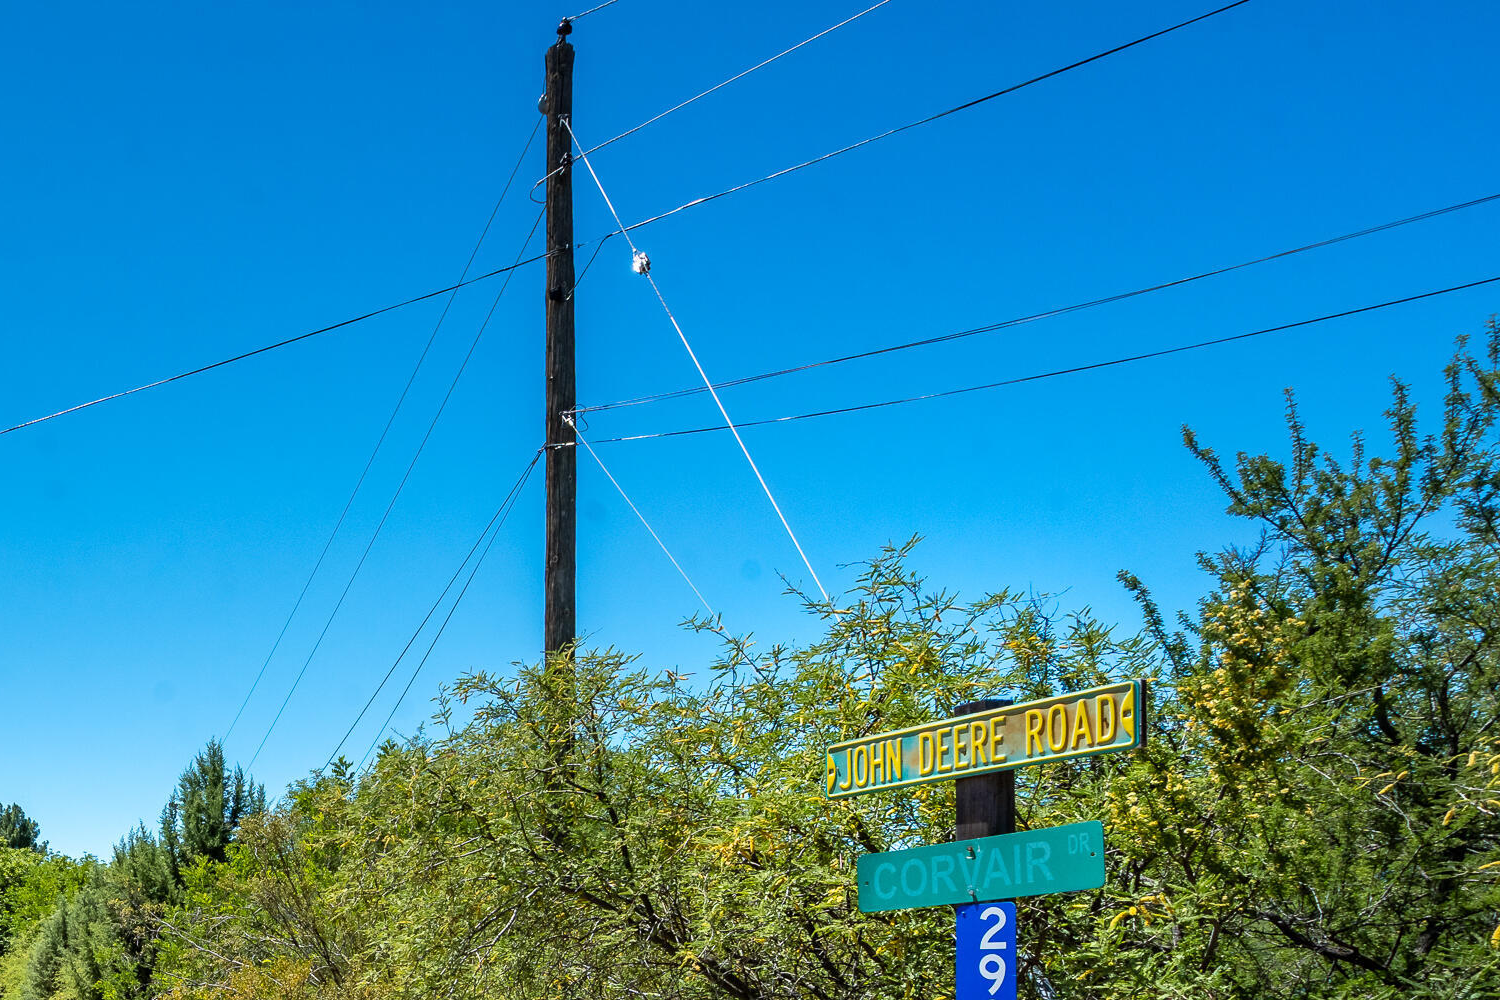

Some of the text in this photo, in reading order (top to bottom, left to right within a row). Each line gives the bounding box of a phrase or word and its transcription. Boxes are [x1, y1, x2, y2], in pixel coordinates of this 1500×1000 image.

[839, 694, 1116, 790] JOHN DEERE ROAD
[873, 832, 1090, 900] CORVAIR DR
